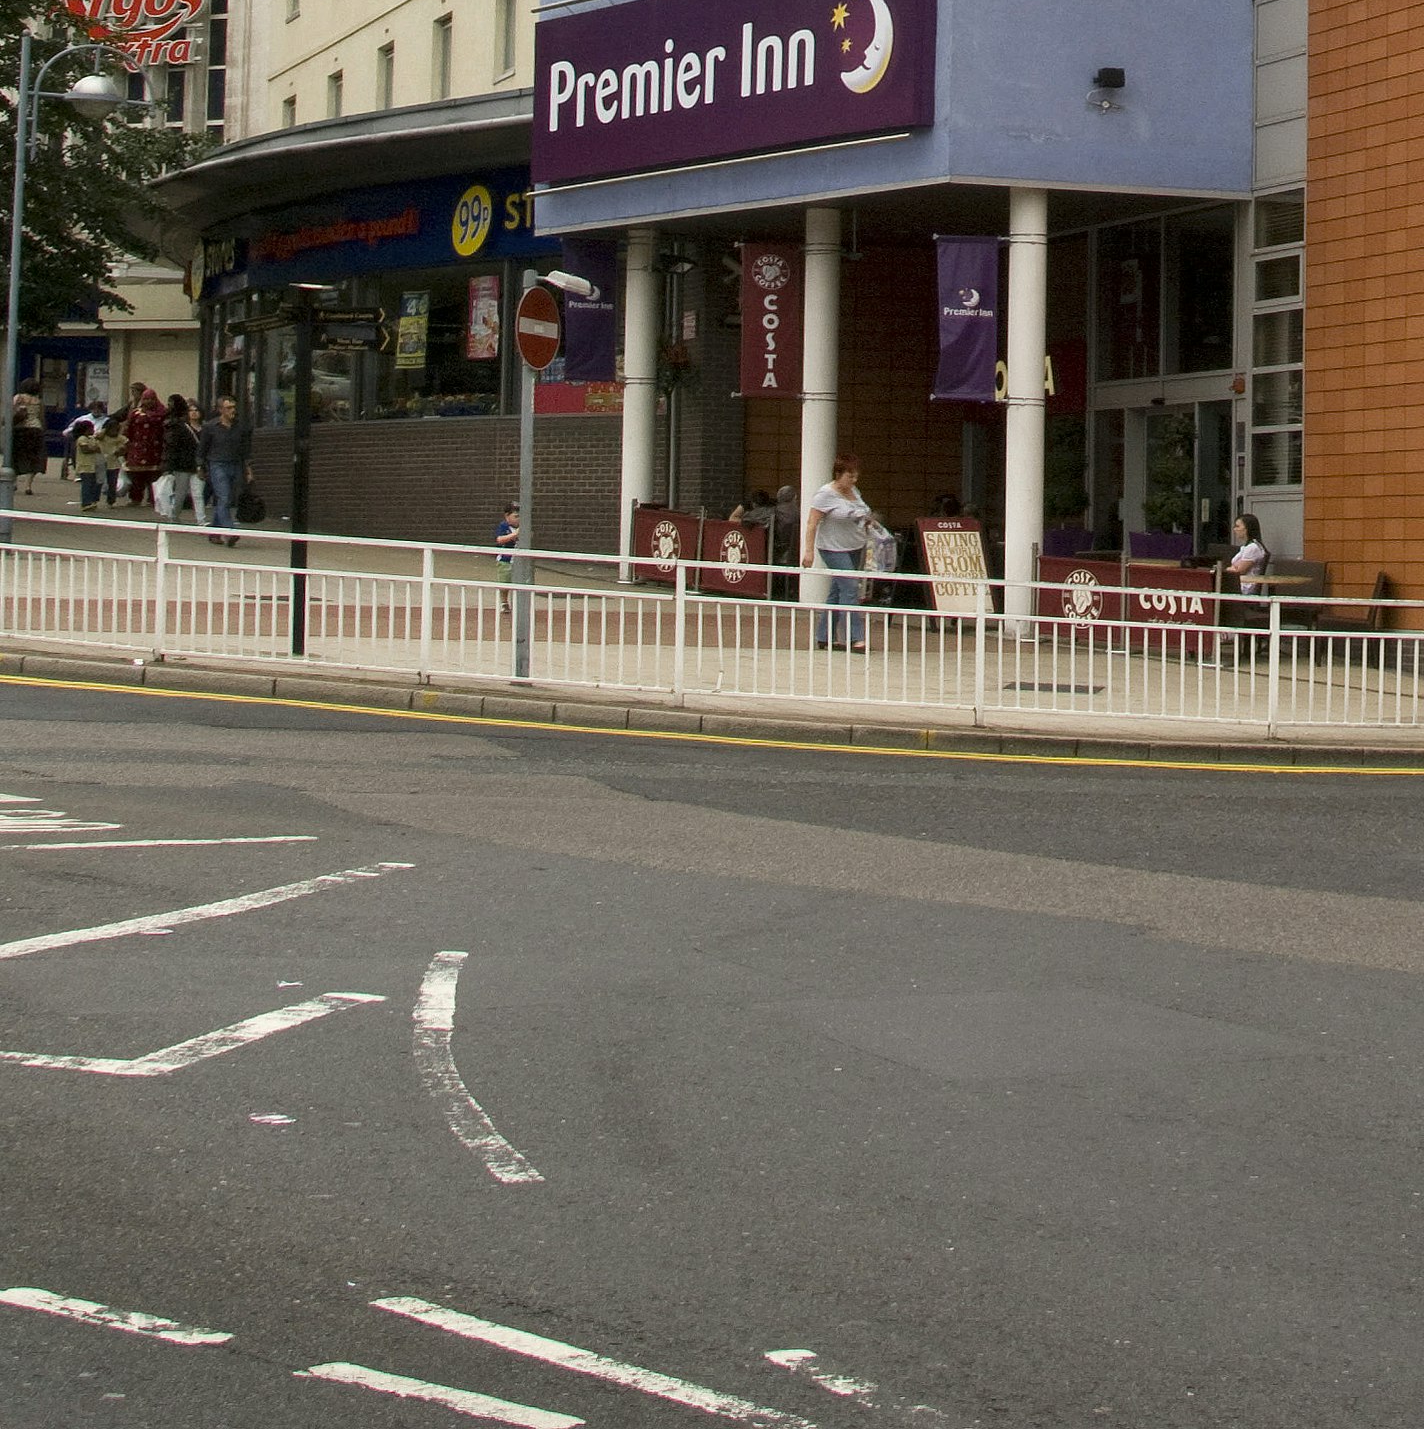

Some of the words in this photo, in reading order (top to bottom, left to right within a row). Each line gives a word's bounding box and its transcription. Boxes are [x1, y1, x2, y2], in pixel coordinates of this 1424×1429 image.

[112, 38, 191, 73] xtra
[549, 38, 727, 132] Premier
[740, 22, 816, 98] Inn
[458, 194, 490, 245] 99p
[757, 255, 785, 268] COSTA
[943, 307, 978, 317] Premier
[979, 308, 994, 318] Inn
[762, 293, 780, 389] COSTA
[655, 522, 677, 540] COSTA
[937, 521, 962, 529] COSTA
[723, 532, 744, 549] COSTA
[926, 532, 978, 548] SAVING
[930, 555, 984, 573] FROM
[1067, 571, 1097, 587] COSTA
[1138, 588, 1205, 616] COSTA
